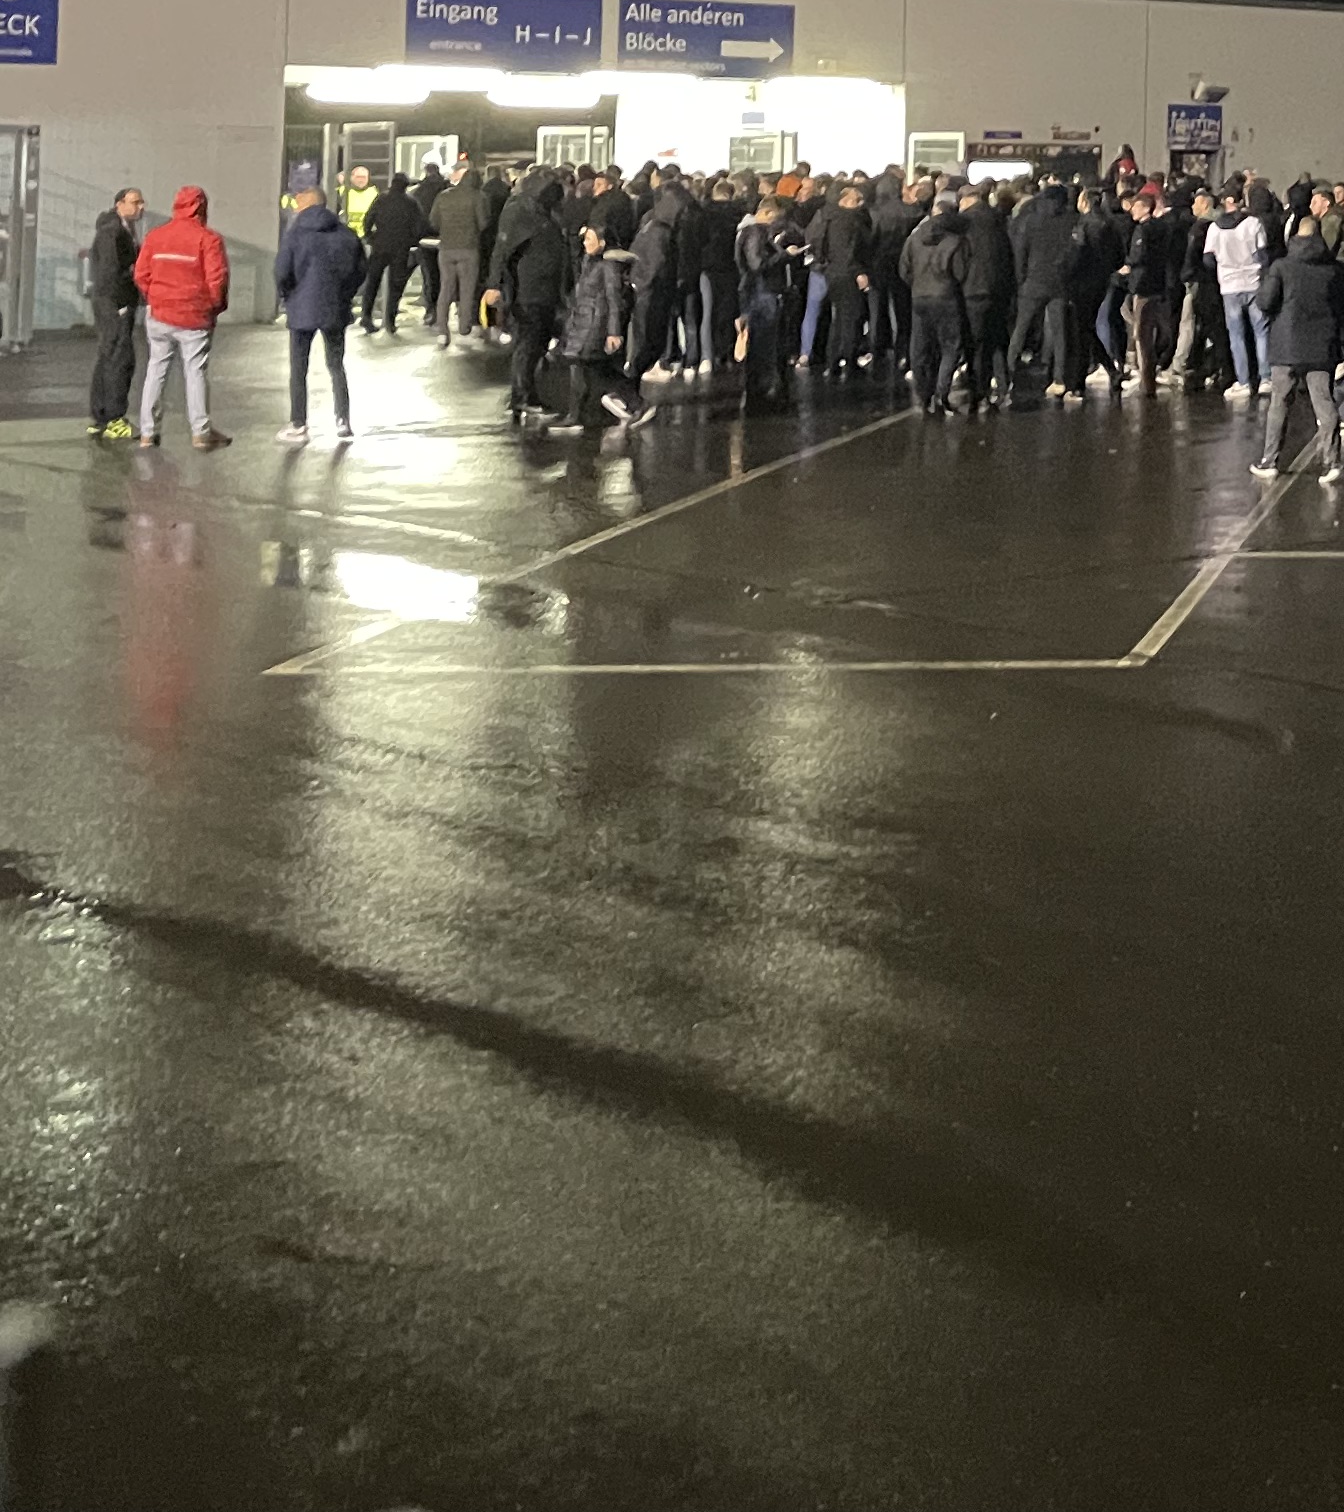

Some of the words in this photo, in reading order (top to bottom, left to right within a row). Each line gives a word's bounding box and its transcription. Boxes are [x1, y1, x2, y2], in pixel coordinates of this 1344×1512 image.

[416, 0, 499, 25] Eingang
[625, 3, 662, 23] Alle
[625, 32, 687, 52] Blöcke
